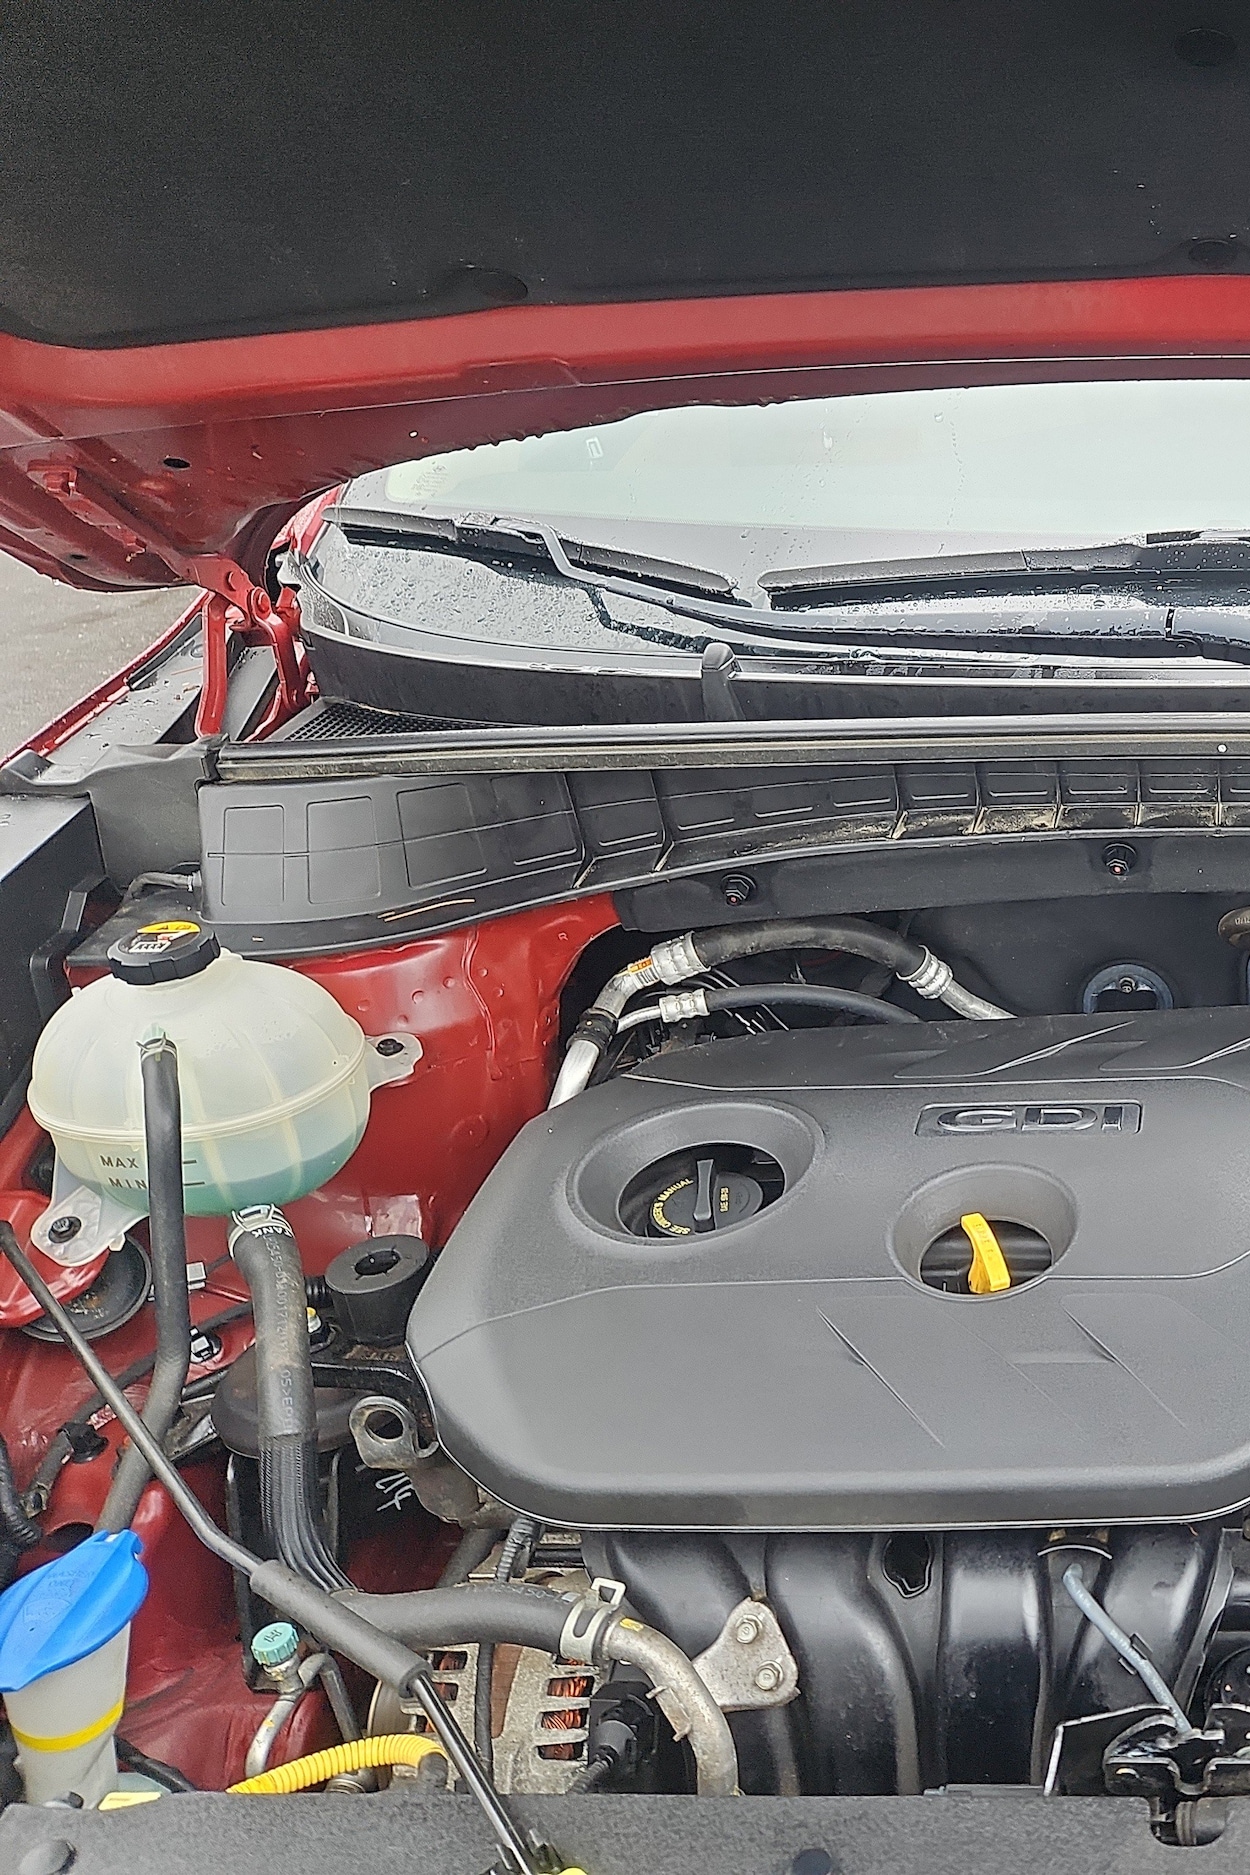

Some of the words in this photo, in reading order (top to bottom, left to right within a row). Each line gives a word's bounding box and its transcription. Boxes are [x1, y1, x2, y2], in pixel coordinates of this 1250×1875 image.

[937, 1106, 1122, 1132] GDI
[100, 1154, 139, 1169] MAX
[108, 1177, 148, 1189] MIN
[658, 1178, 694, 1201] MANUAL
